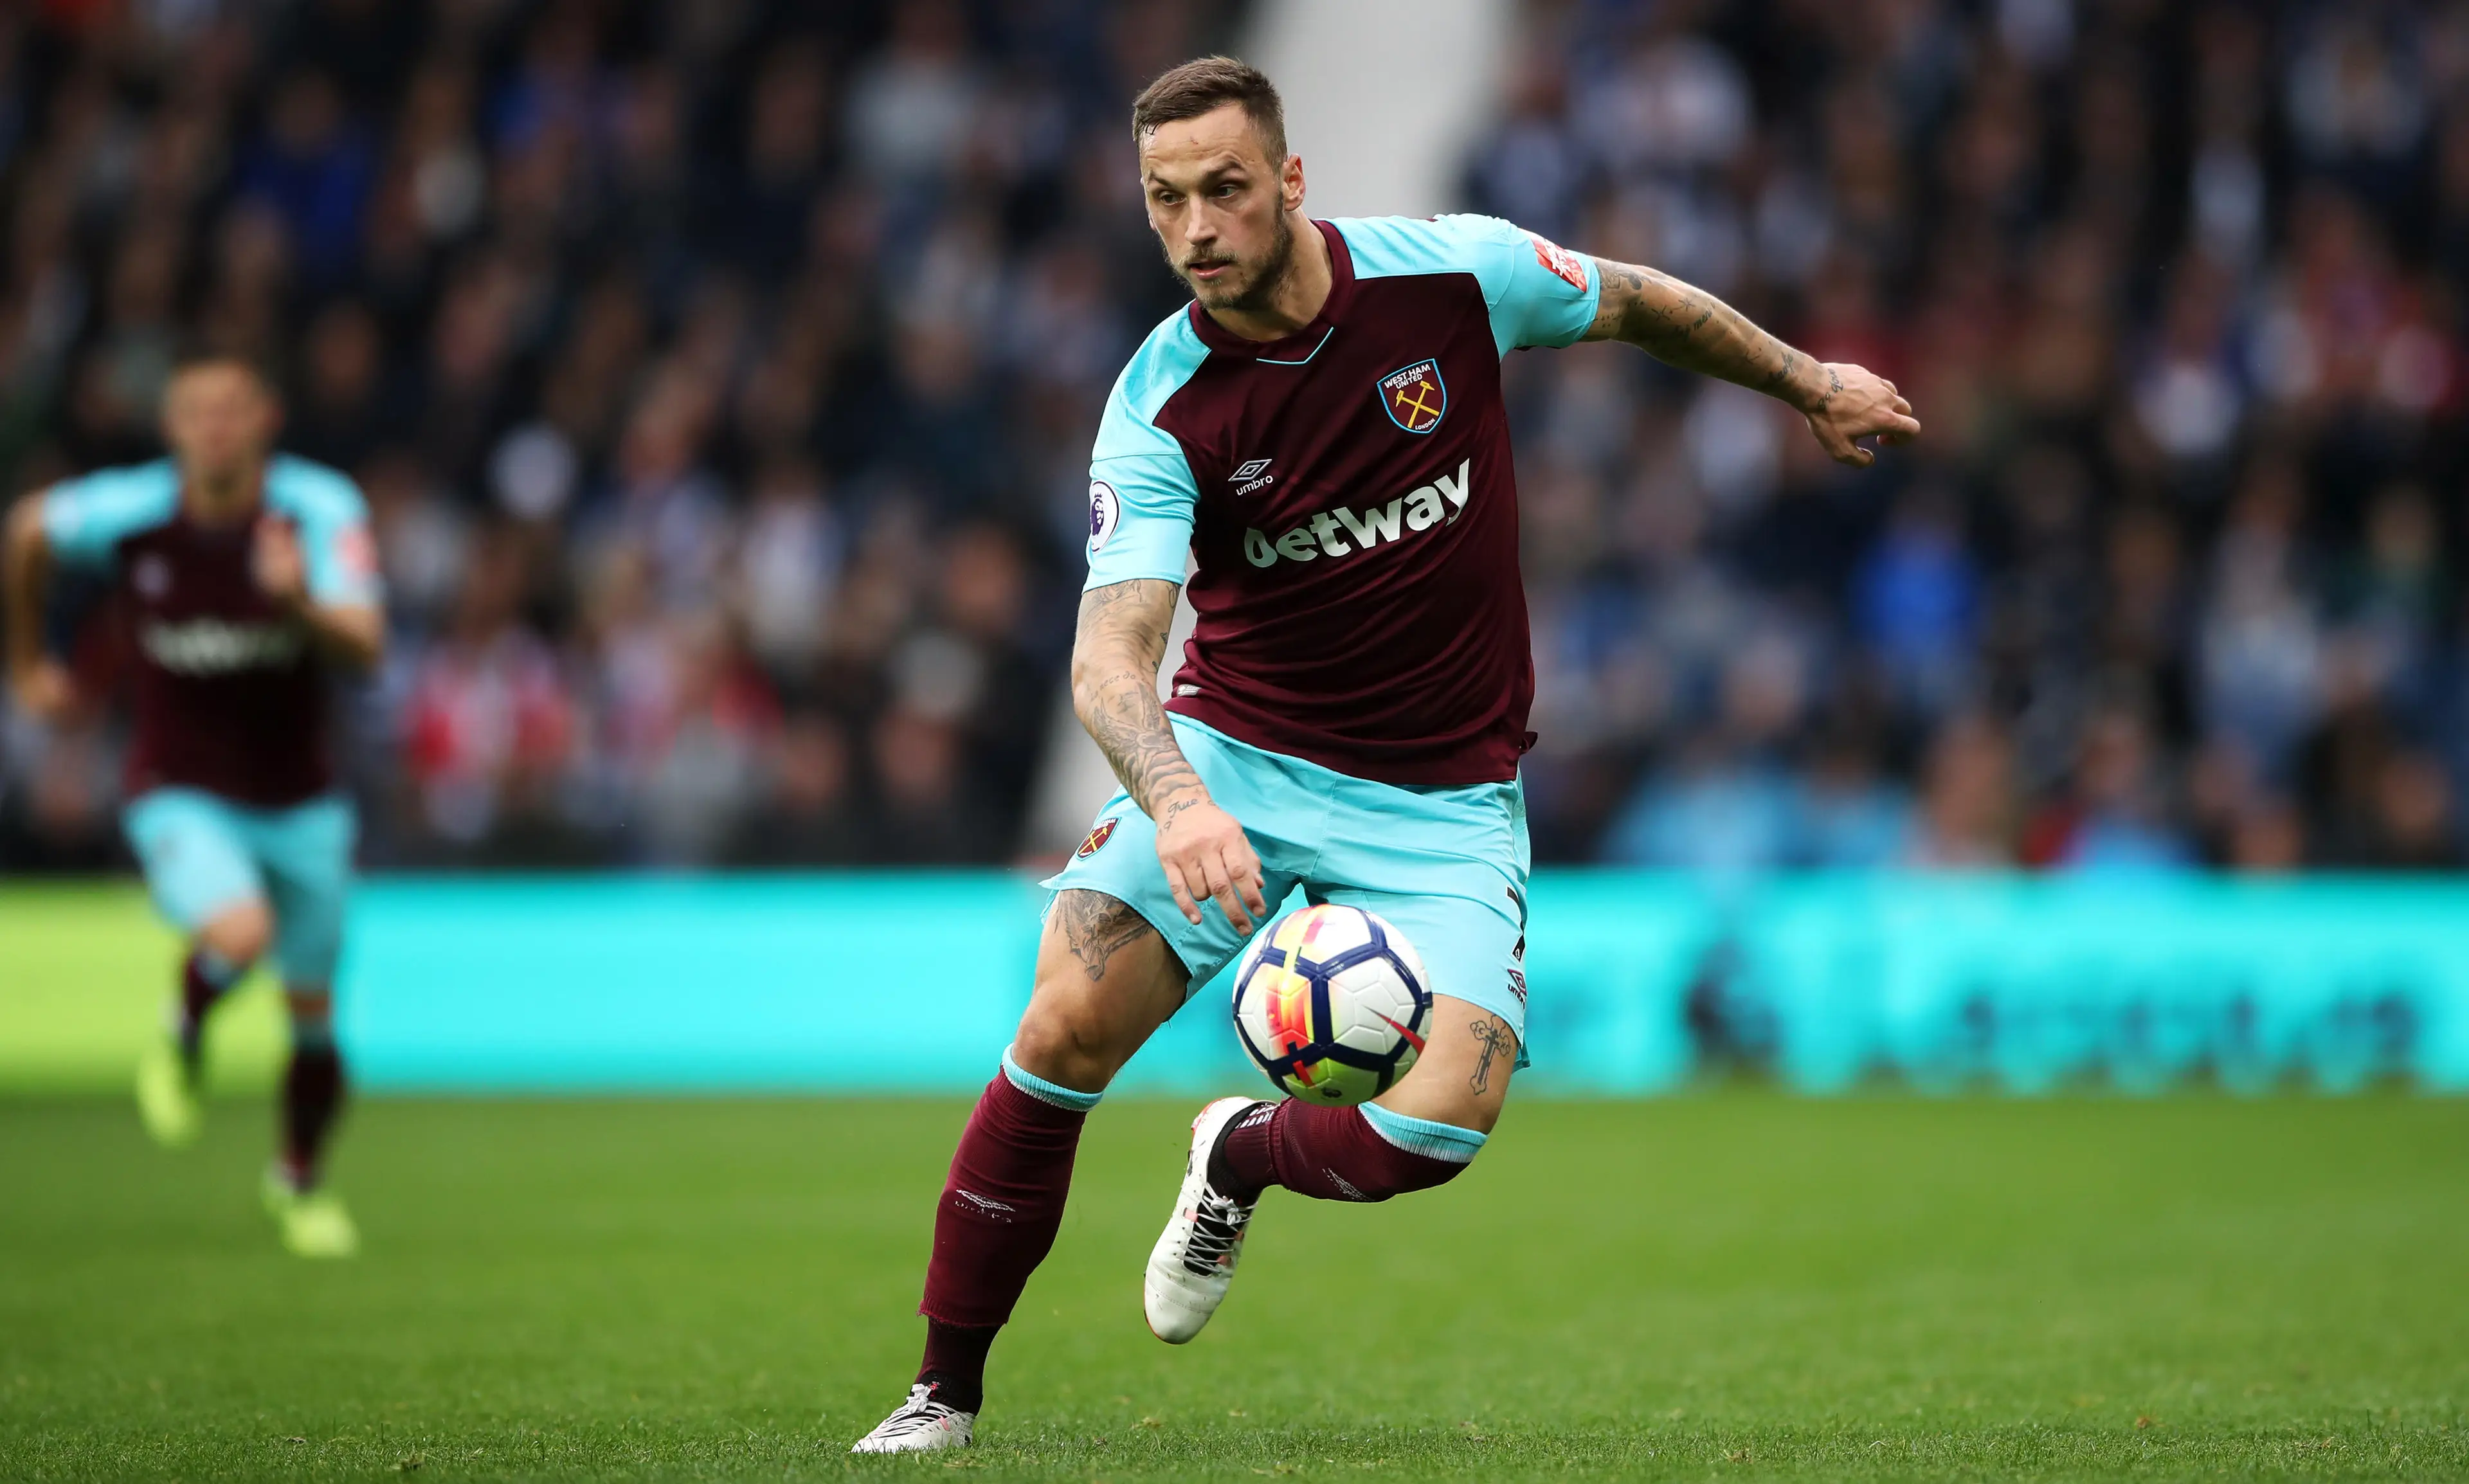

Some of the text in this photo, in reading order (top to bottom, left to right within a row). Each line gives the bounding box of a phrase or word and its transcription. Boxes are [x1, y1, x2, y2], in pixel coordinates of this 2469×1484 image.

[1384, 363, 1431, 388] WEST HAM
[1395, 374, 1423, 390] UNITED
[1415, 418, 1436, 430] LONDON
[1236, 475, 1273, 496] umbro
[1244, 458, 1470, 568] betway
